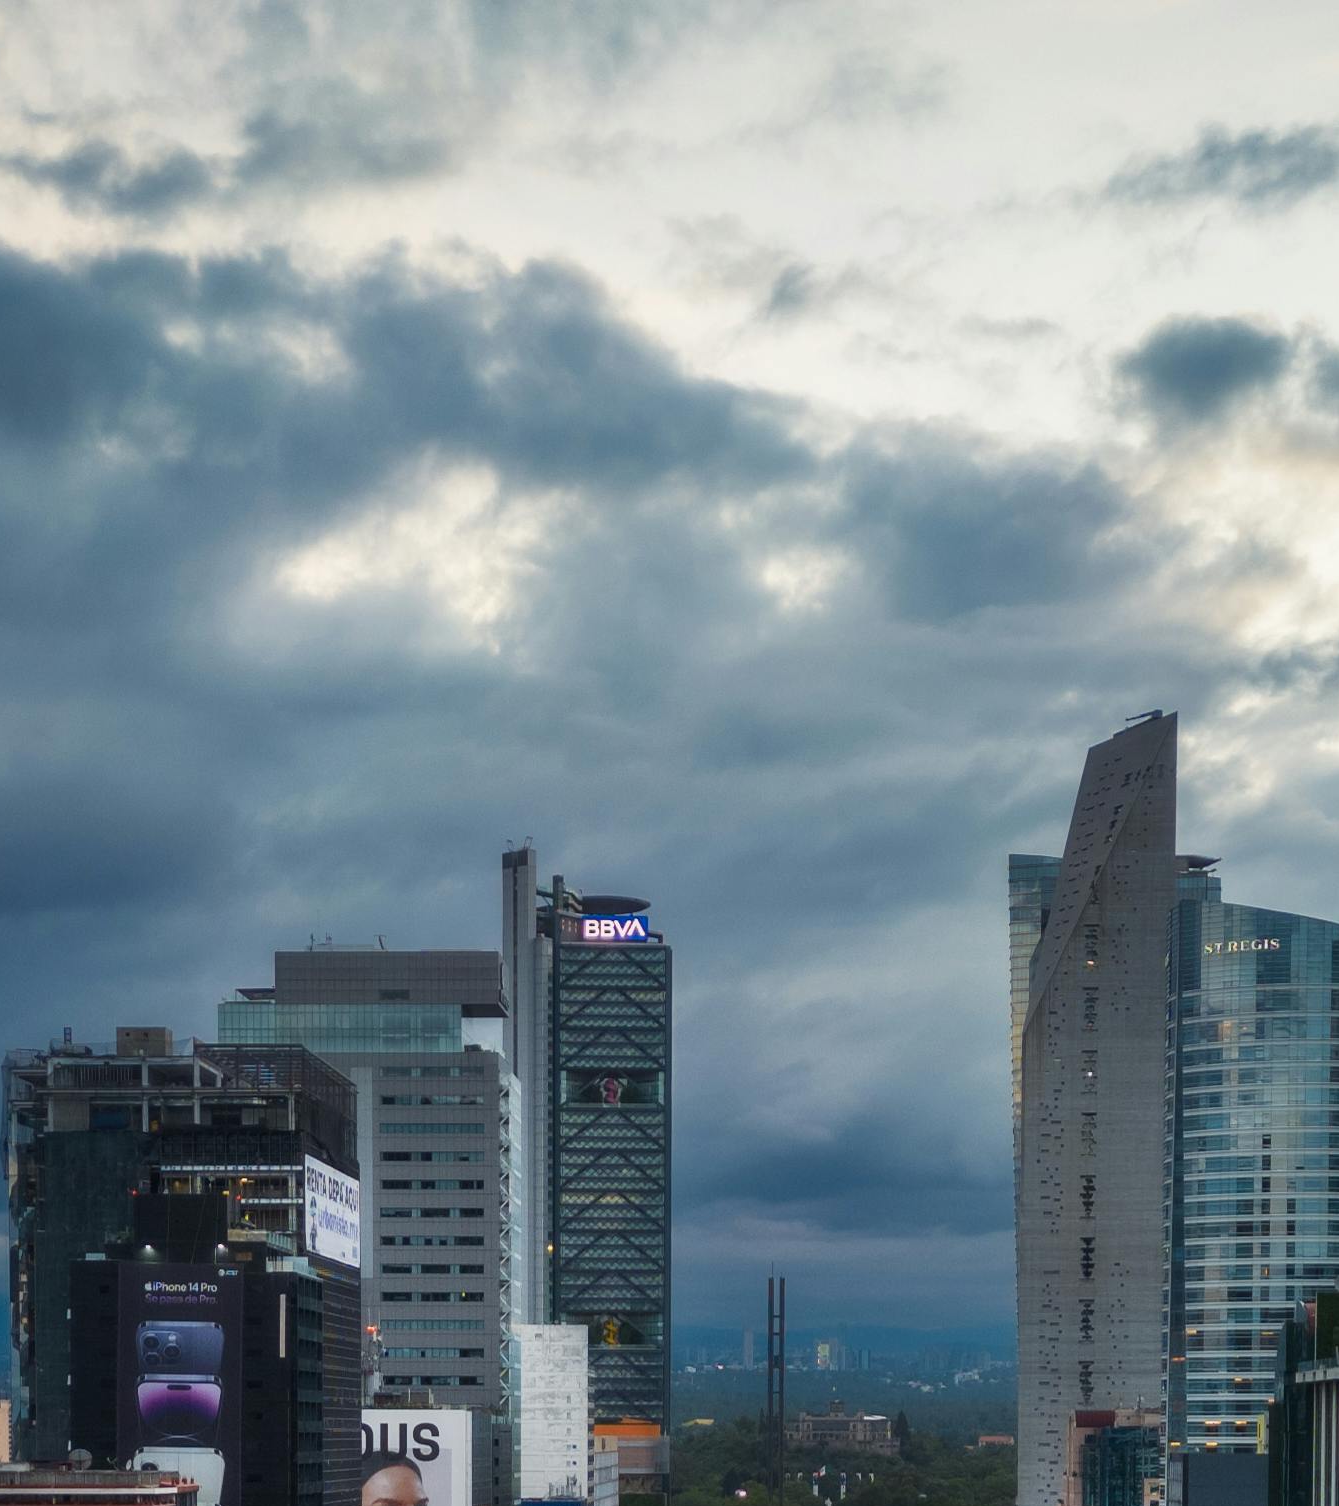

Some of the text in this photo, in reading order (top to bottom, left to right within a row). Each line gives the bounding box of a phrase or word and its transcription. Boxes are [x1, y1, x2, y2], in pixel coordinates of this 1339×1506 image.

[584, 917, 646, 938] BBVA
[1228, 938, 1280, 953] REGIS
[306, 1165, 327, 1196] RENTA
[153, 1281, 218, 1292] iPhone 14 Pro
[145, 1293, 219, 1305] Se pasa de Pro.
